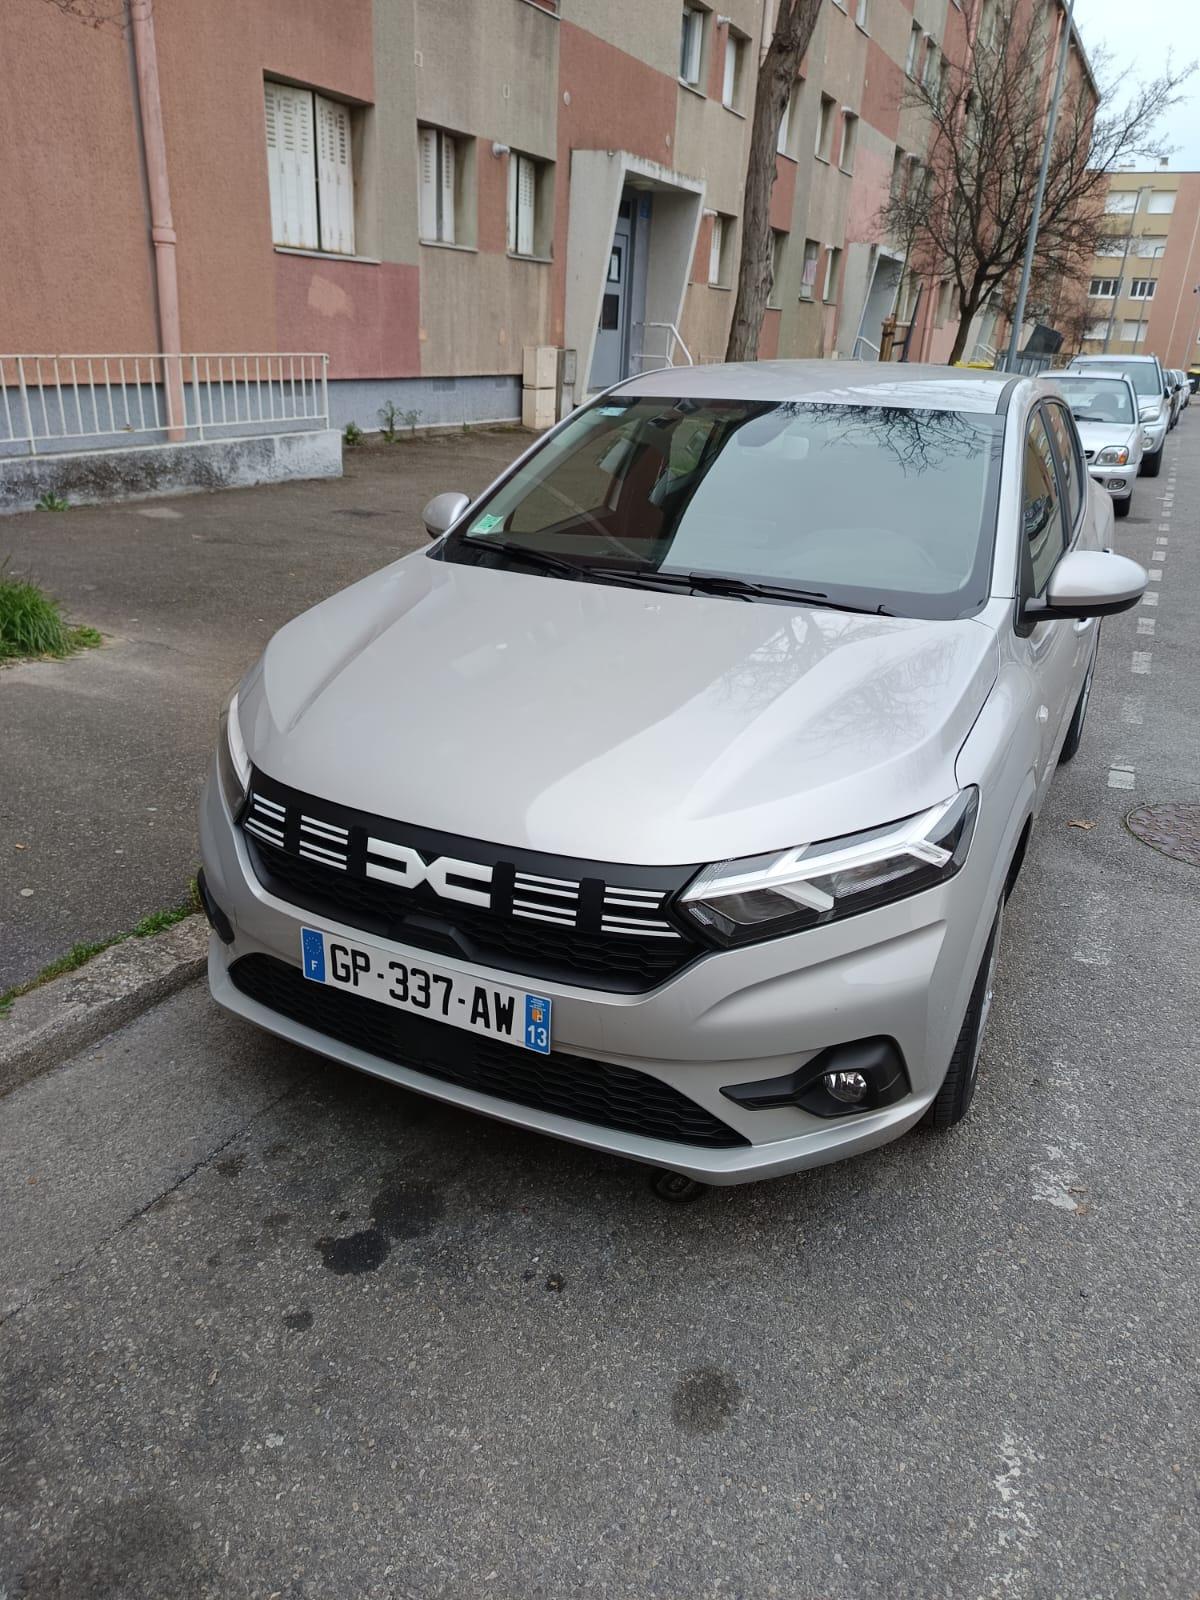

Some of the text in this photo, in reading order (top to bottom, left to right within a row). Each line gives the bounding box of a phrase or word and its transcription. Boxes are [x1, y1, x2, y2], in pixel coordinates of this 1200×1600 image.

[311, 959, 318, 971] F
[330, 943, 515, 1035] GP-337-AW
[527, 1024, 547, 1047] 13
